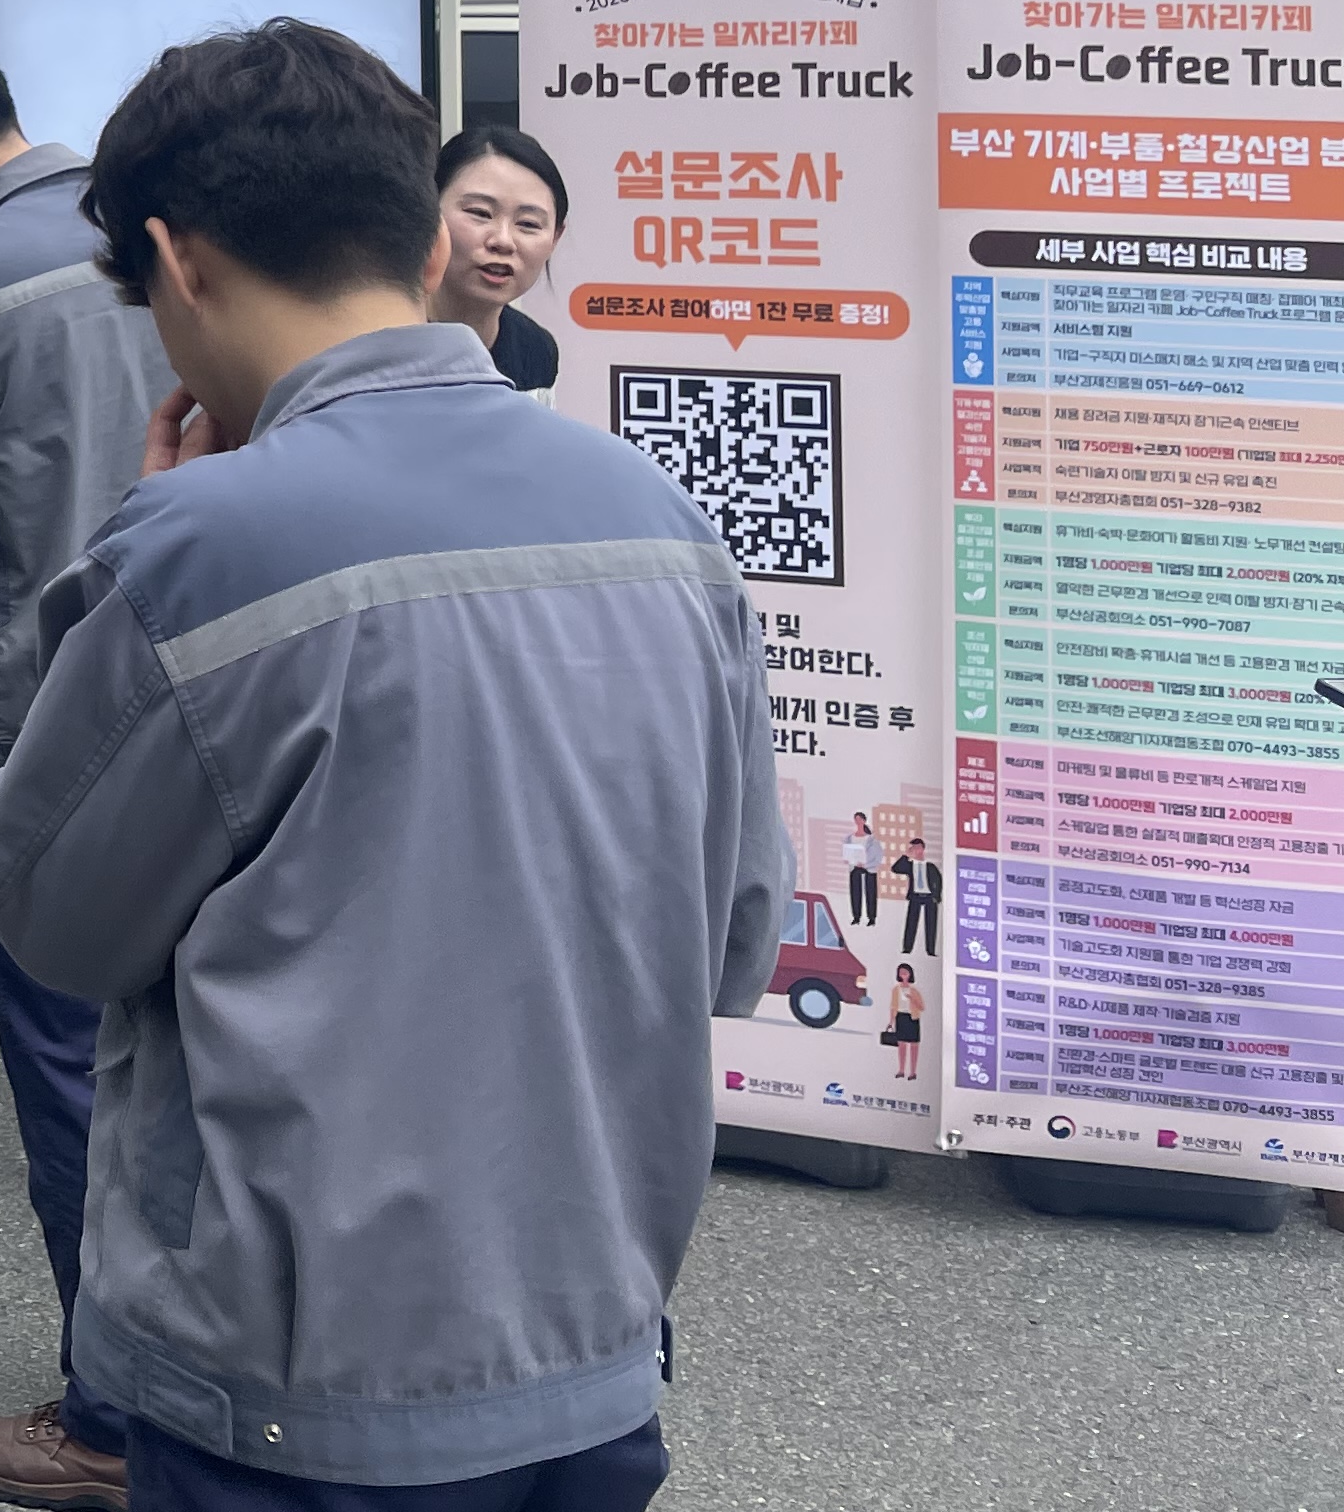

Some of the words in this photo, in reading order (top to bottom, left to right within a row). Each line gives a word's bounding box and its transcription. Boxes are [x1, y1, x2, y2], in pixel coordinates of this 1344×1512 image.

[1023, 2, 1146, 28] 찾아가는
[1155, 3, 1312, 32] 일자리카페
[594, 22, 704, 48] 찾아가는
[713, 20, 858, 47] 일자리카페
[544, 62, 780, 98] Job-Coffee
[792, 61, 914, 98] Truck
[967, 44, 1230, 86] Job-Coffee
[1242, 48, 1343, 88] Truc
[950, 128, 1015, 158] 부산
[1024, 129, 1309, 166] 기계·부품·철강산업
[1320, 137, 1344, 168] 분
[614, 151, 843, 202] 설문조사
[1051, 167, 1148, 198] 사업별
[1158, 170, 1291, 202] 프로젝트
[634, 216, 821, 269] QR코드
[1036, 239, 1085, 263] 세부
[1091, 242, 1140, 265] 사업
[1146, 243, 1196, 267] 핵심
[1202, 246, 1251, 269] 비교
[1257, 247, 1307, 272] 내용
[586, 296, 665, 317] 설문조사
[670, 298, 752, 321] 참여하면
[757, 301, 787, 322] 1잔
[792, 303, 833, 323] 무료
[839, 304, 889, 325] 증정!
[1146, 379, 1244, 394] 051-669-0612
[1160, 497, 1262, 513] 051-328-9382
[776, 614, 800, 638] 및
[1149, 615, 1250, 632] 051-990-7087
[765, 645, 882, 678] 참여한다.
[826, 700, 879, 729] 인증
[888, 706, 915, 731] 후
[1227, 741, 1340, 760] 070-4493-3855
[1151, 855, 1250, 874] 051-990-7134
[1165, 978, 1265, 997] 051-328-9385
[749, 1077, 804, 1095] 부산광역시
[1223, 1101, 1334, 1121] 070-4493-3855
[1082, 1125, 1139, 1141] 고용노동부
[1182, 1136, 1242, 1152] 부산광역시
[1293, 1149, 1344, 1163] 부산경제
